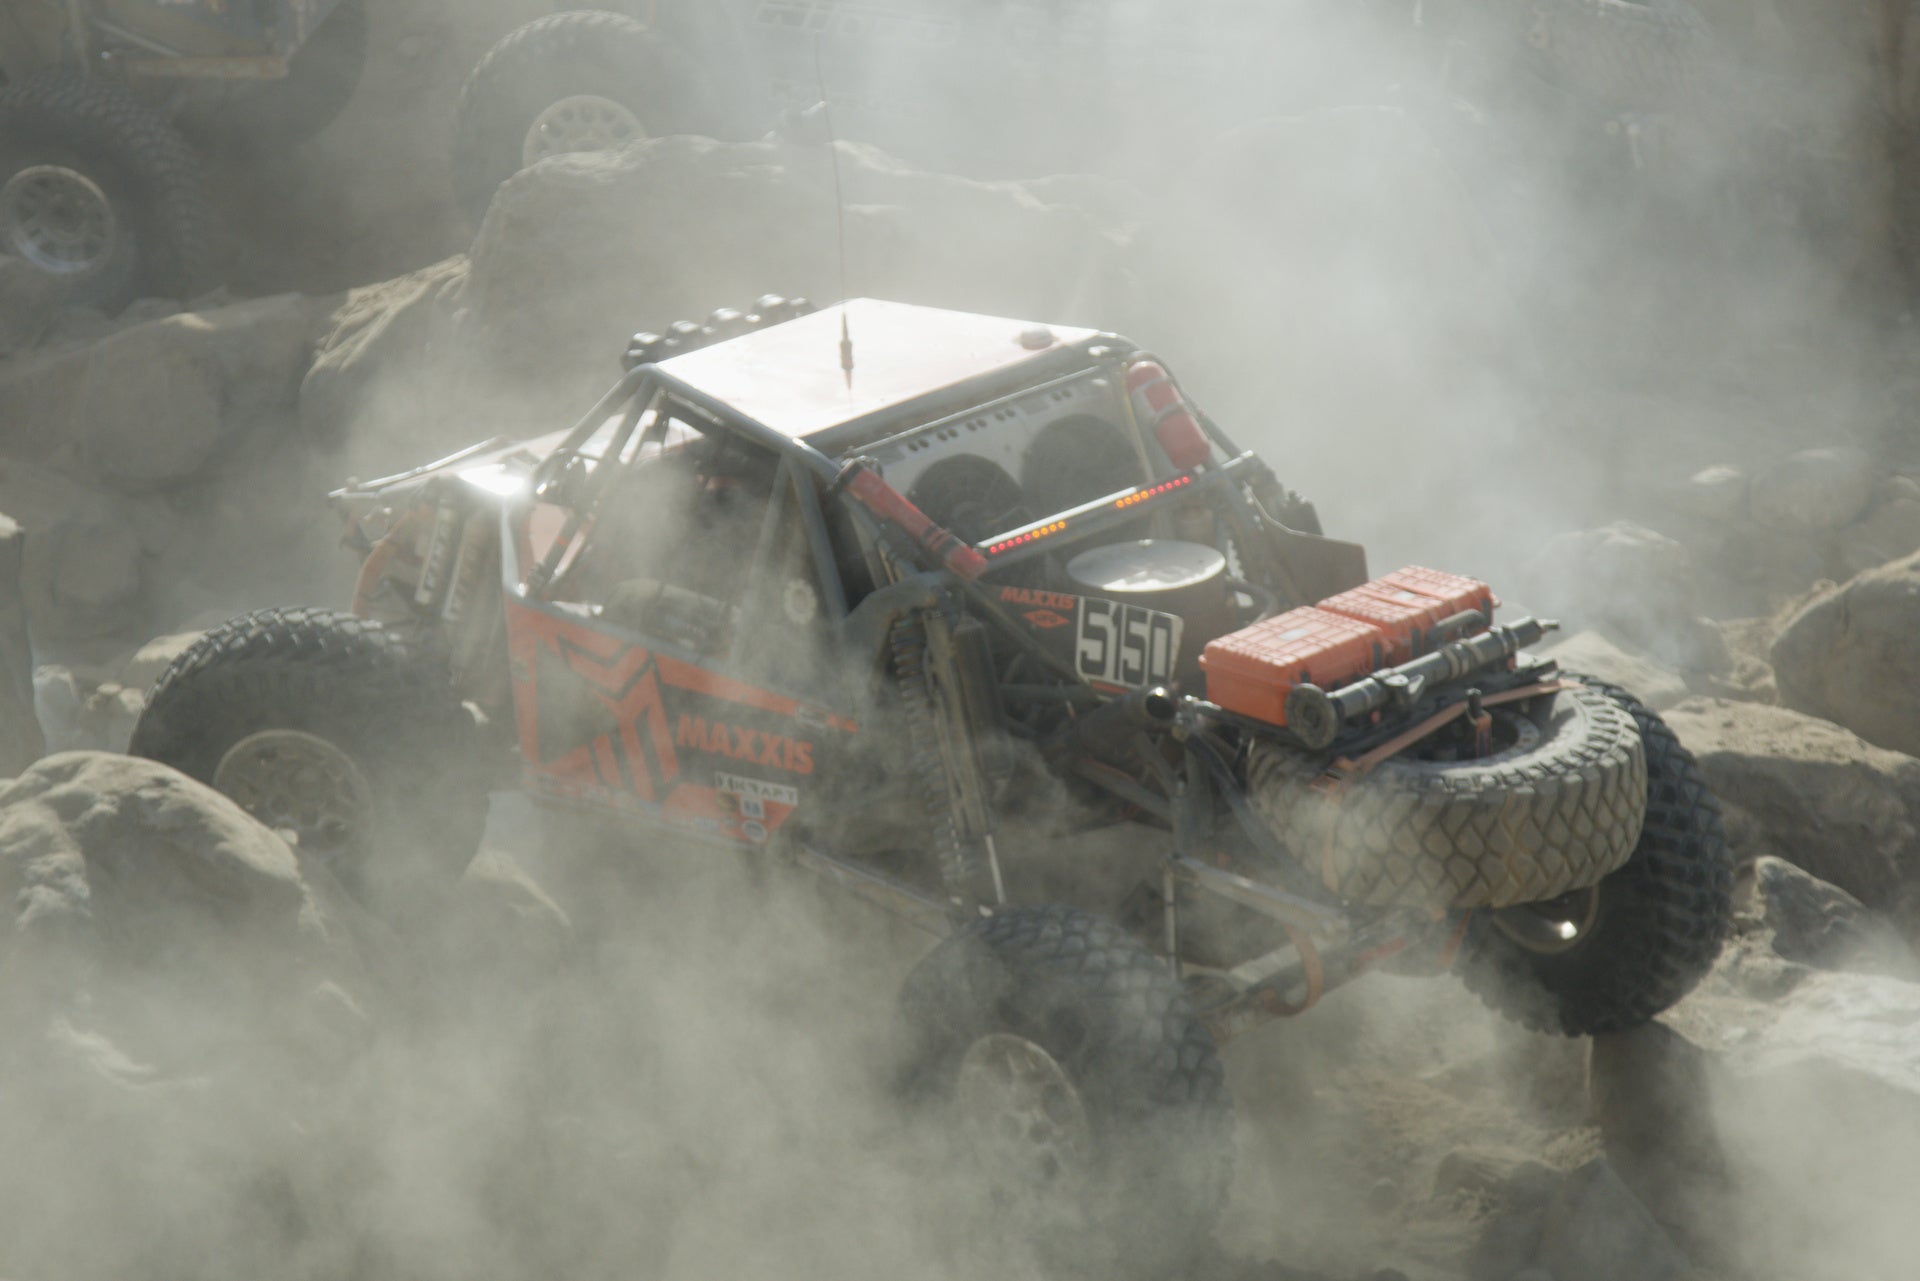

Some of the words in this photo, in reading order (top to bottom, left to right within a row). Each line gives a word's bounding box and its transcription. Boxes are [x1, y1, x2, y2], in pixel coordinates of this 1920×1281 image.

[1002, 587, 1075, 611] MAXXIS
[1080, 598, 1173, 687] 5150
[675, 714, 815, 774] MAXXIS
